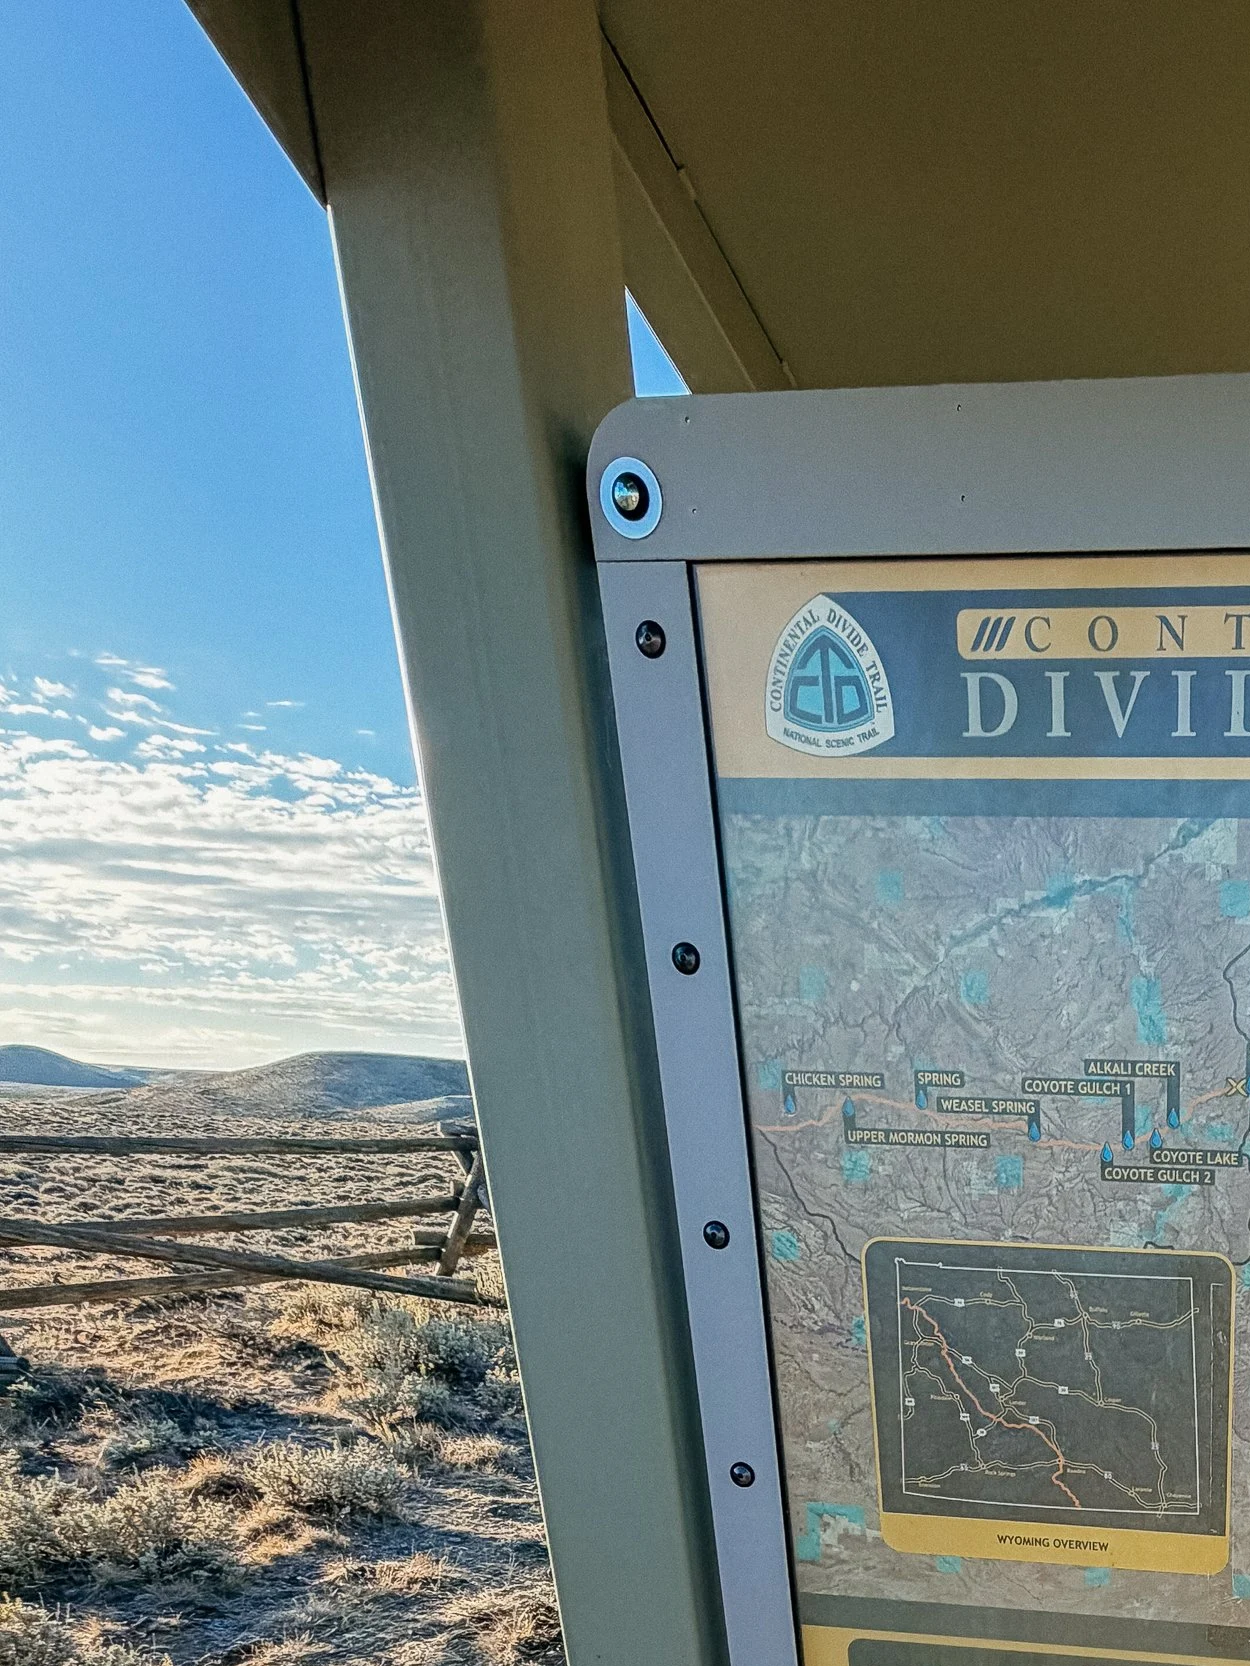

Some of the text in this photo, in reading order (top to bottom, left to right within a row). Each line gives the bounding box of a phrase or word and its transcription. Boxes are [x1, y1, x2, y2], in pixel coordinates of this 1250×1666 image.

[770, 608, 887, 713] CONTINENTAL DIVIDE TRAIL
[783, 727, 880, 748] NATIONAL SCENIC TRAIL
[1088, 1062, 1175, 1076] ALKALI CREEK
[785, 1073, 881, 1087] CHICKEN SPRING
[918, 1072, 960, 1085] SPRING
[1024, 1080, 1131, 1094] COYOTE GULCH 1
[941, 1099, 1035, 1113] WEASEL SPRING
[848, 1131, 987, 1146] UPPER MORMON SPRING
[1153, 1151, 1238, 1165] COYOTE LAKE
[1105, 1168, 1211, 1183] COYOTE GULCH 2
[997, 1535, 1108, 1551] WYOMING OVERVIEW
